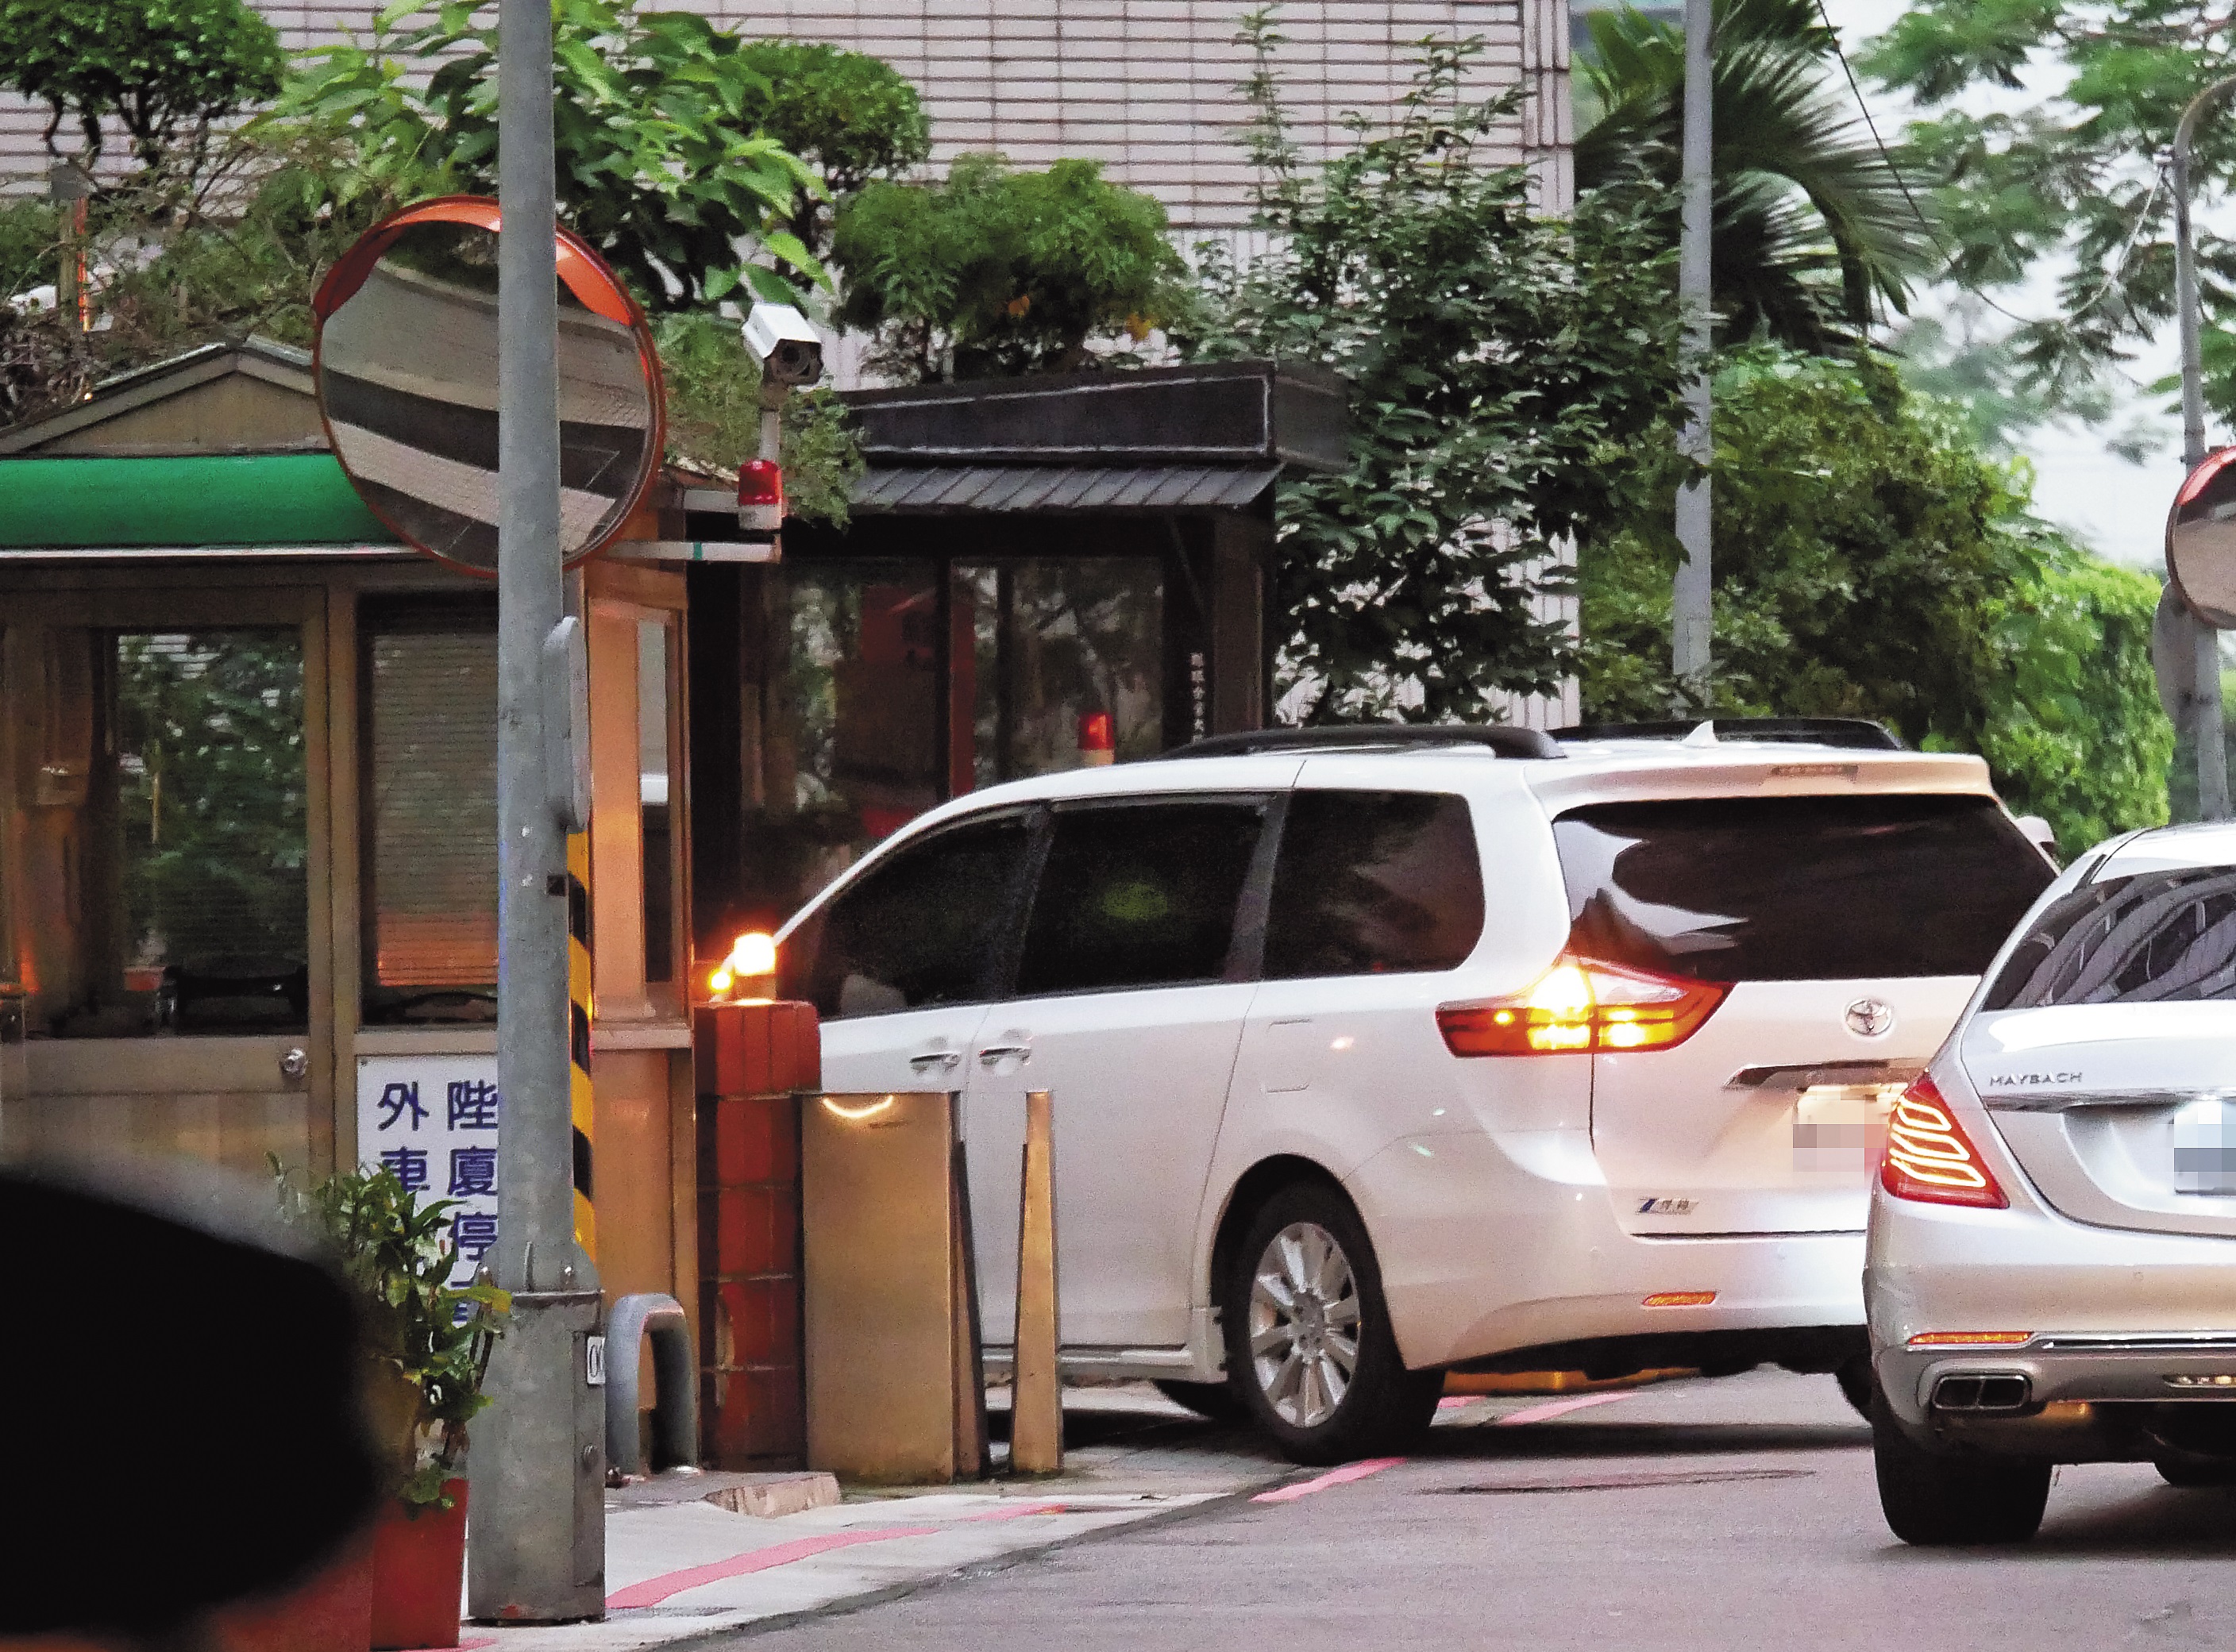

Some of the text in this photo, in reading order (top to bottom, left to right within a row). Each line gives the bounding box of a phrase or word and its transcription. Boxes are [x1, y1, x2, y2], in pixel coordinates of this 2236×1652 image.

[1989, 1072, 2083, 1086] MAYBACH
[447, 1079, 498, 1324] 陛廈停
